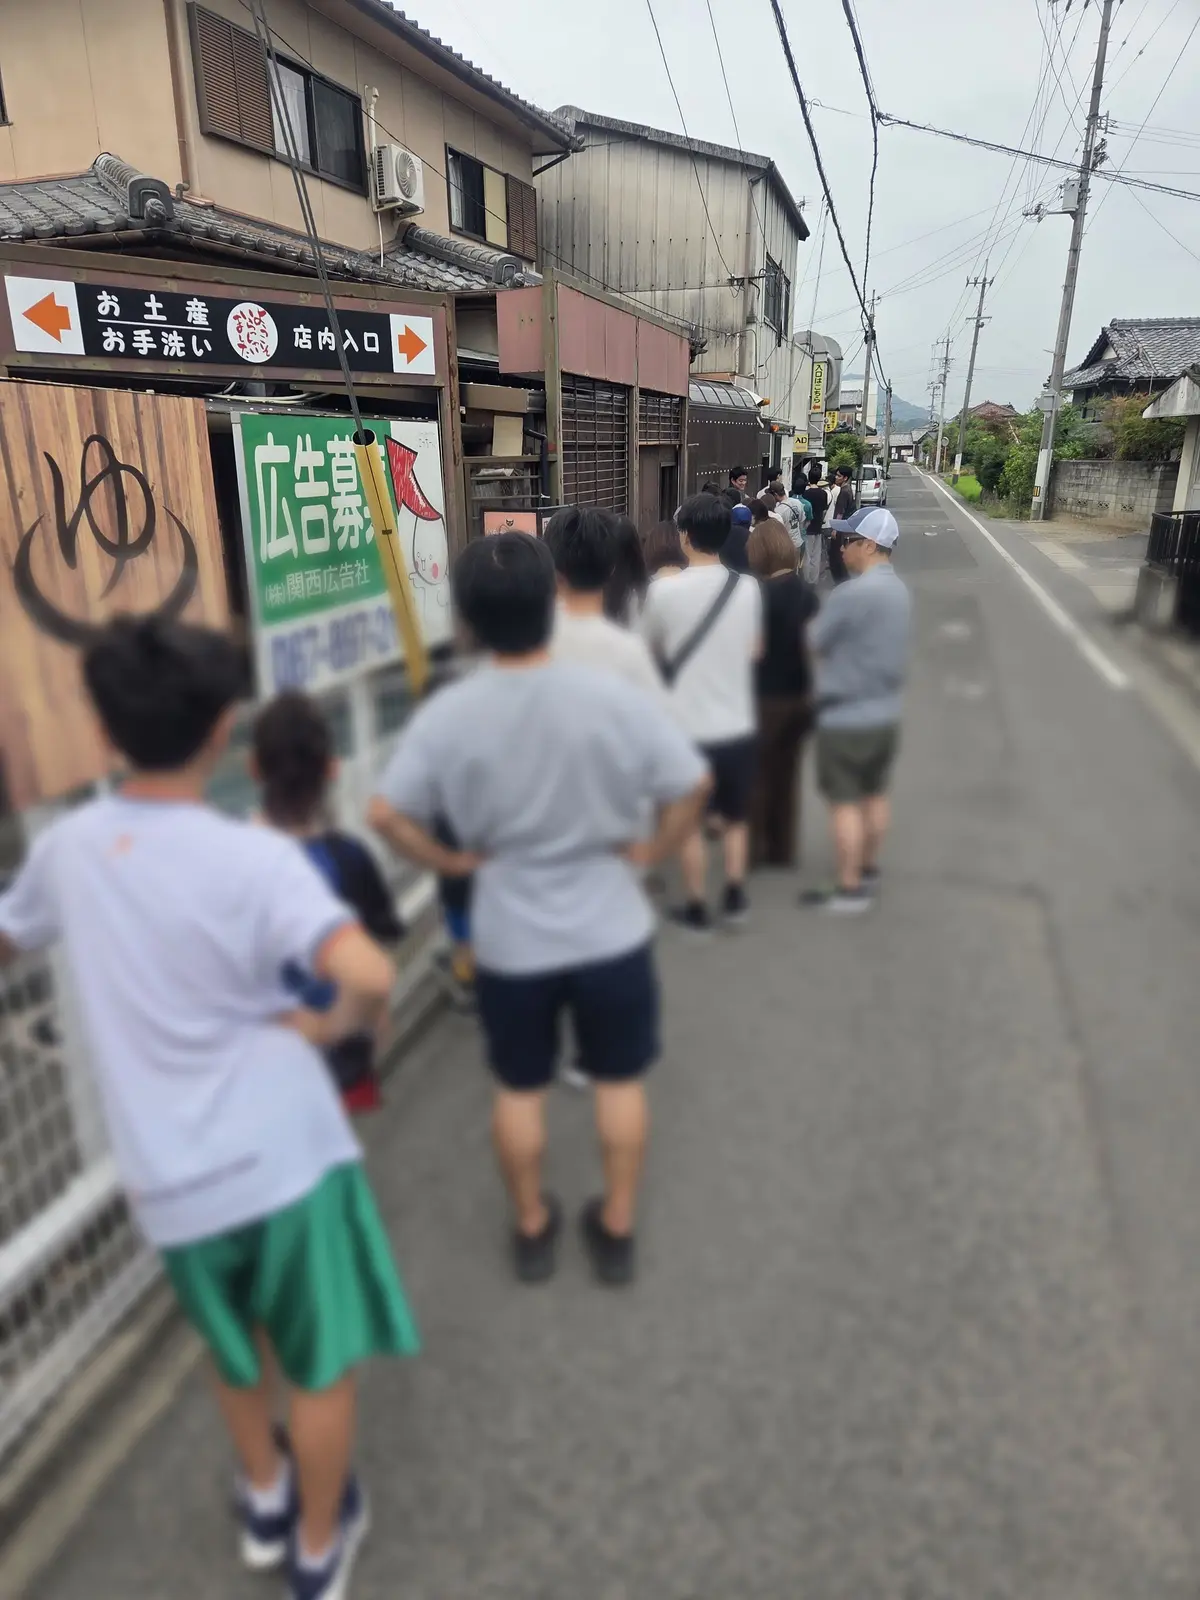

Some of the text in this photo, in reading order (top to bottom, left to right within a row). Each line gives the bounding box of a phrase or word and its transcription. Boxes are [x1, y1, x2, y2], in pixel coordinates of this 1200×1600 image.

[97, 290, 210, 326] お土産
[102, 326, 213, 358] お手洗い
[293, 325, 380, 354] 店内入口
[814, 364, 823, 404] 入口はこちら
